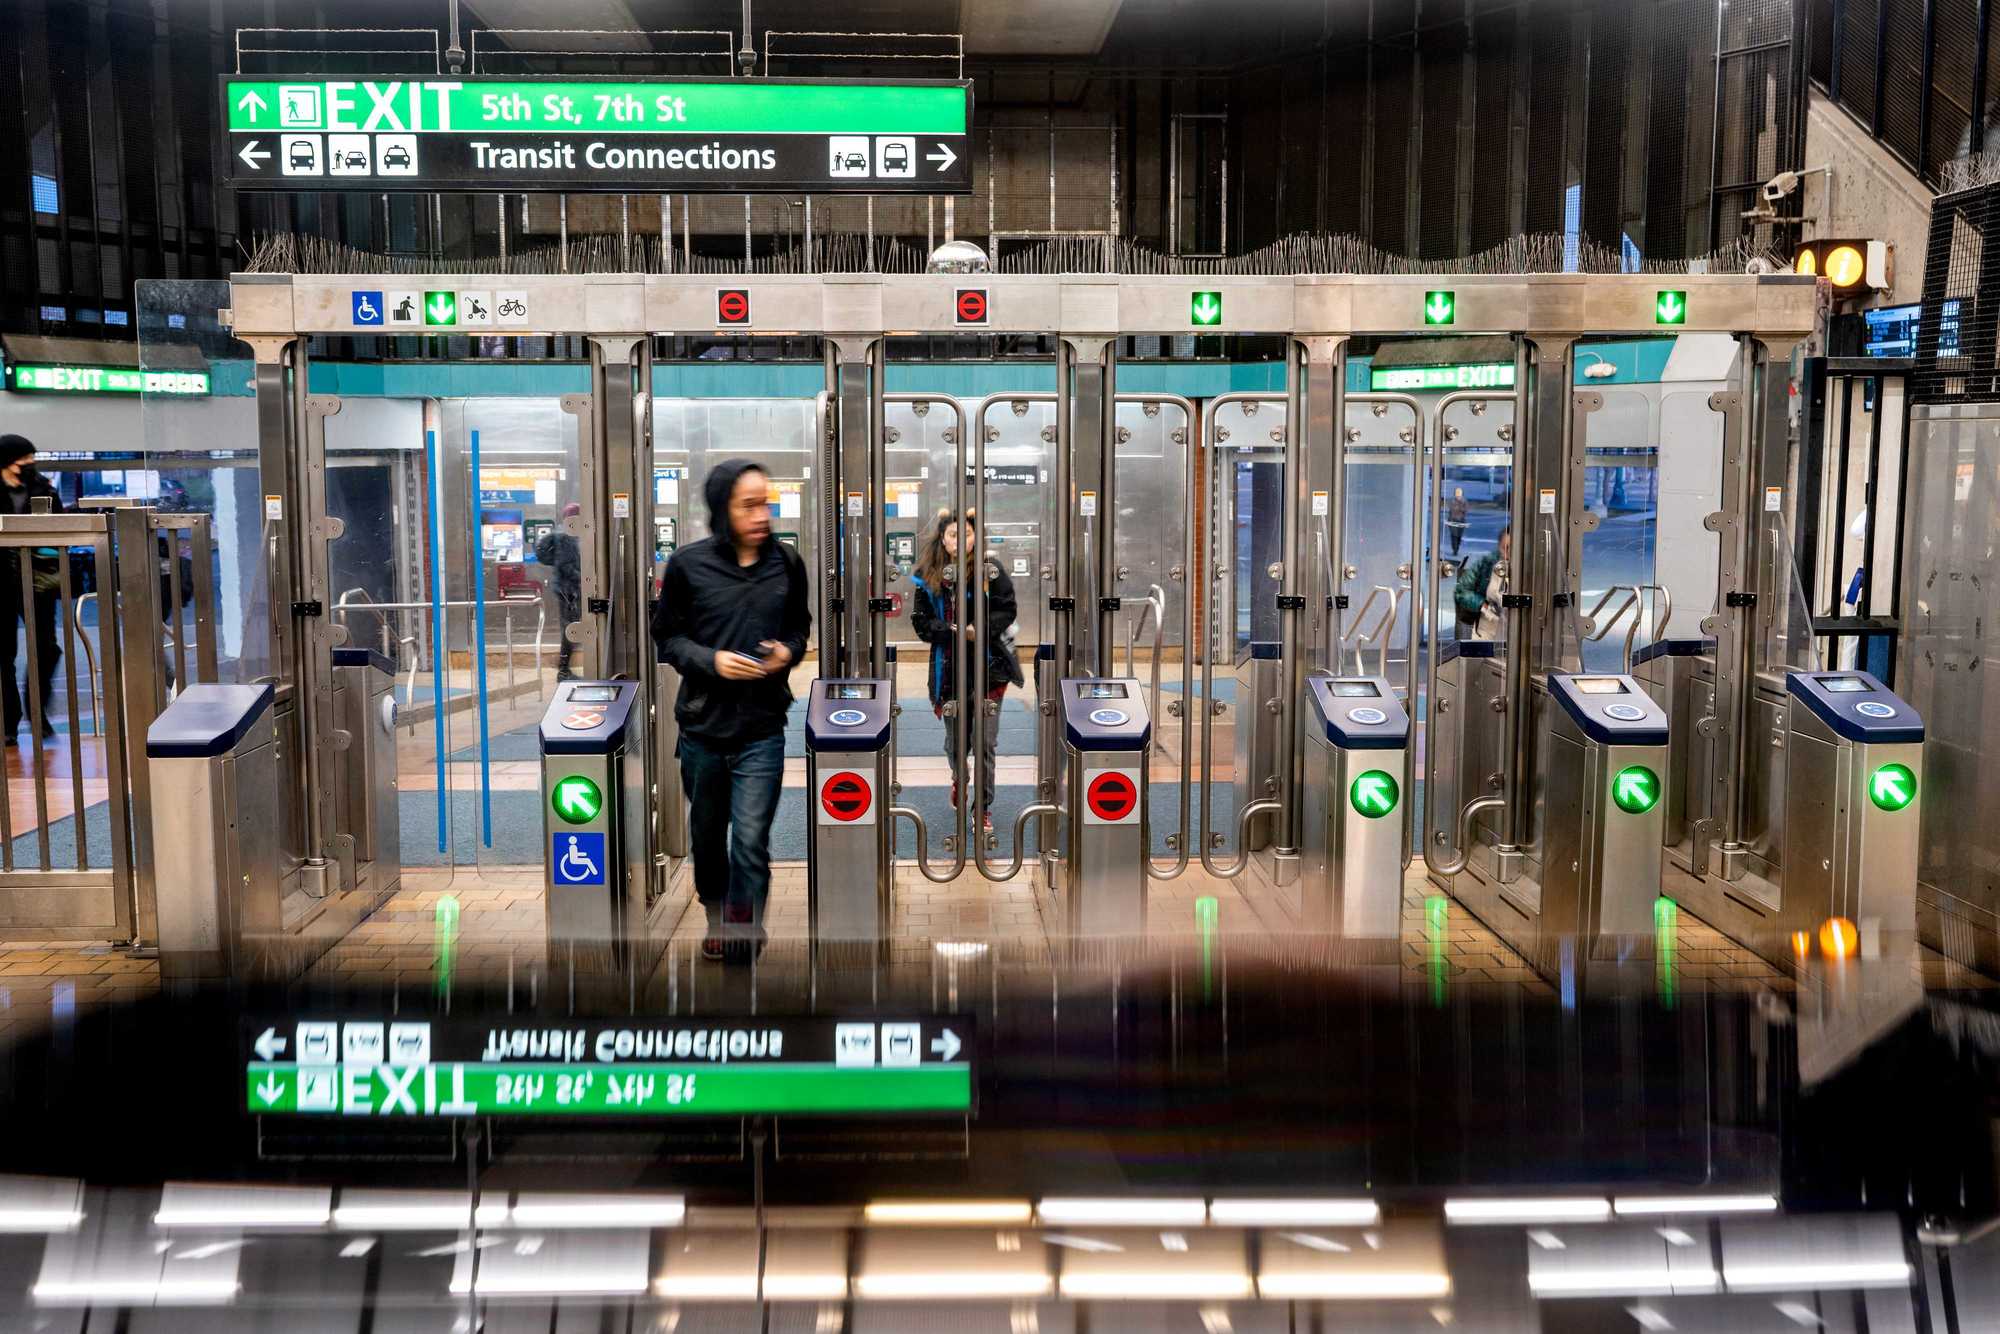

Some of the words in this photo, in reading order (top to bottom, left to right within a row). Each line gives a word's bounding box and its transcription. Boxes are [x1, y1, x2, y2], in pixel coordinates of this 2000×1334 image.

[326, 81, 462, 131] EXIT
[482, 92, 532, 121] 5th
[543, 94, 582, 125] St,
[593, 92, 645, 122] 7th
[655, 94, 687, 122] St
[470, 141, 576, 170] Transit
[585, 141, 777, 171] Connections
[54, 368, 103, 390] EXIT
[1458, 366, 1498, 387] EXIT
